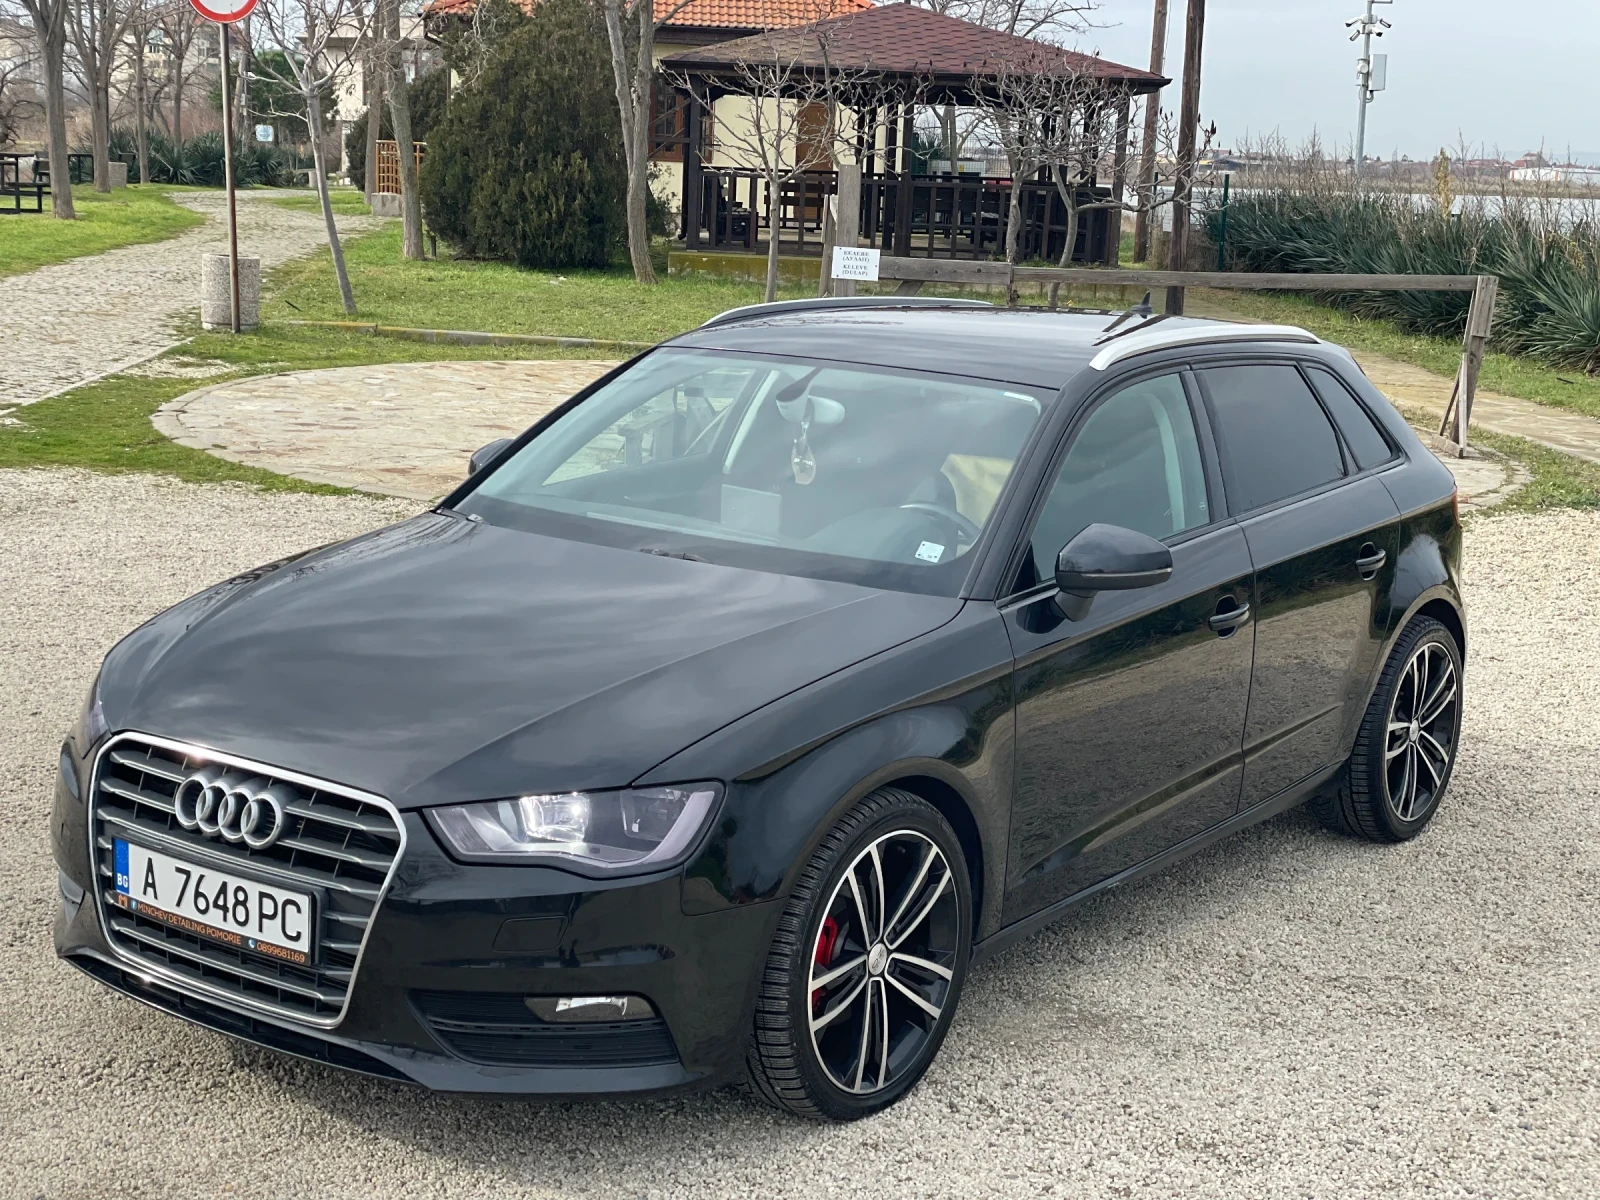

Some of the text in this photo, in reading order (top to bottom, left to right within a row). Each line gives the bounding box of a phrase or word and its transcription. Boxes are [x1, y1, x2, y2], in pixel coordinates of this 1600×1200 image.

[117, 873, 129, 887] BG
[142, 857, 158, 900] A
[137, 901, 242, 945] MINCHEV DETAILING POMORIE
[256, 941, 305, 963] 0899681169
